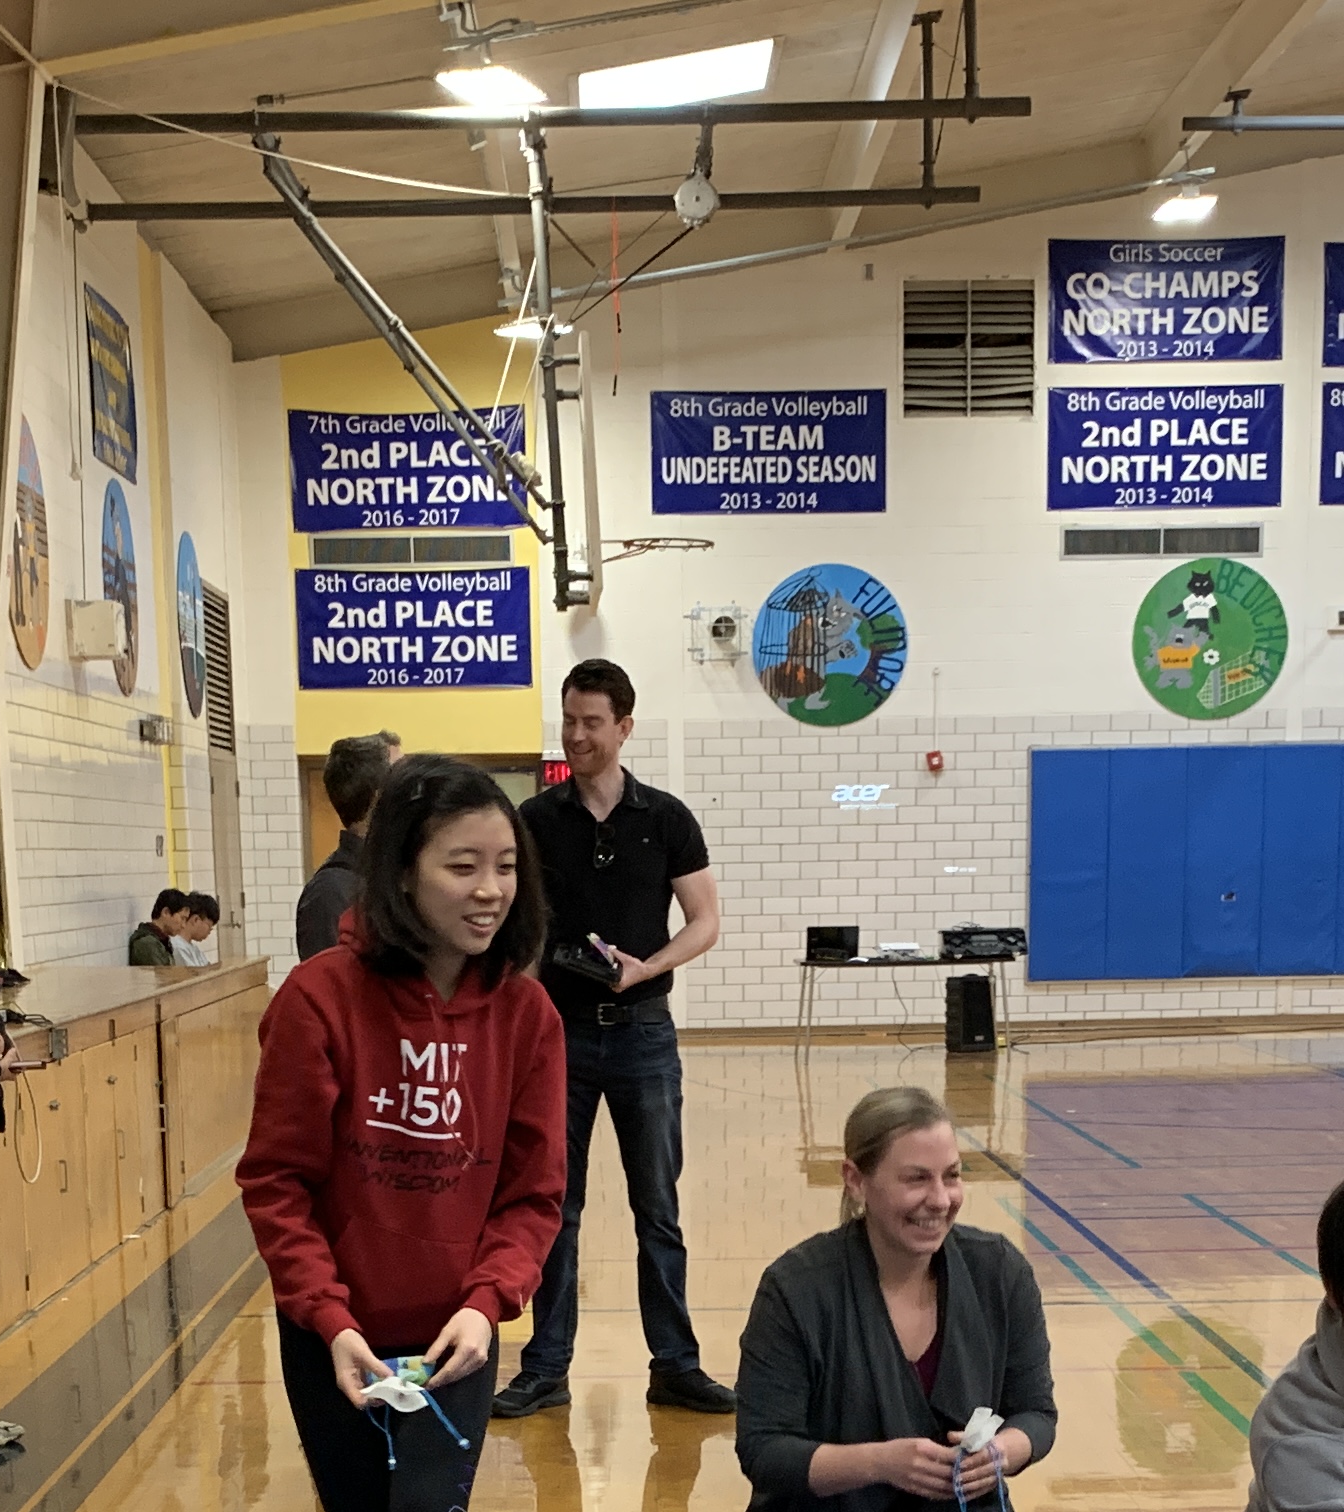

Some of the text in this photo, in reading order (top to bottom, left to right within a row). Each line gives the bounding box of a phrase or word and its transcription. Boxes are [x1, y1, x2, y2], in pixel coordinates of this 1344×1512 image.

[1110, 244, 1224, 262] Girls Soccer
[1066, 271, 1259, 299] CO-CHAMPS
[1063, 306, 1268, 336] NORTH ZONE
[1117, 342, 1158, 357] 2013
[1173, 341, 1214, 357] 2014
[670, 396, 867, 421] 8th Grade Volleyball
[1067, 389, 1265, 414] 8th Grade Volleyball
[308, 415, 340, 434] 7th
[346, 415, 405, 433] Grade
[713, 425, 824, 451] B-TEAM
[1082, 418, 1249, 447] 2nd PLACE
[321, 441, 380, 469] 2nd
[1061, 453, 1267, 483] NORTH ZONE
[661, 456, 876, 484] UNDEFEATED SEASON
[307, 477, 418, 506] NORTH
[720, 493, 761, 509] 2013
[776, 493, 818, 509] 2014
[1115, 488, 1156, 504] 2013
[1171, 487, 1213, 503] 2014
[362, 510, 404, 527] 2016
[419, 509, 460, 525] 2017
[314, 572, 511, 596] 8th Grade Volleyball
[327, 600, 494, 628] 2nd PLACE
[1215, 558, 1288, 687] BEDICHEK
[313, 635, 518, 664] NORTH ZONE
[852, 577, 907, 708] FULMORE
[367, 669, 409, 685] 2016
[423, 668, 464, 684] 2017
[831, 784, 890, 802] acer
[400, 1038, 468, 1083] MIT
